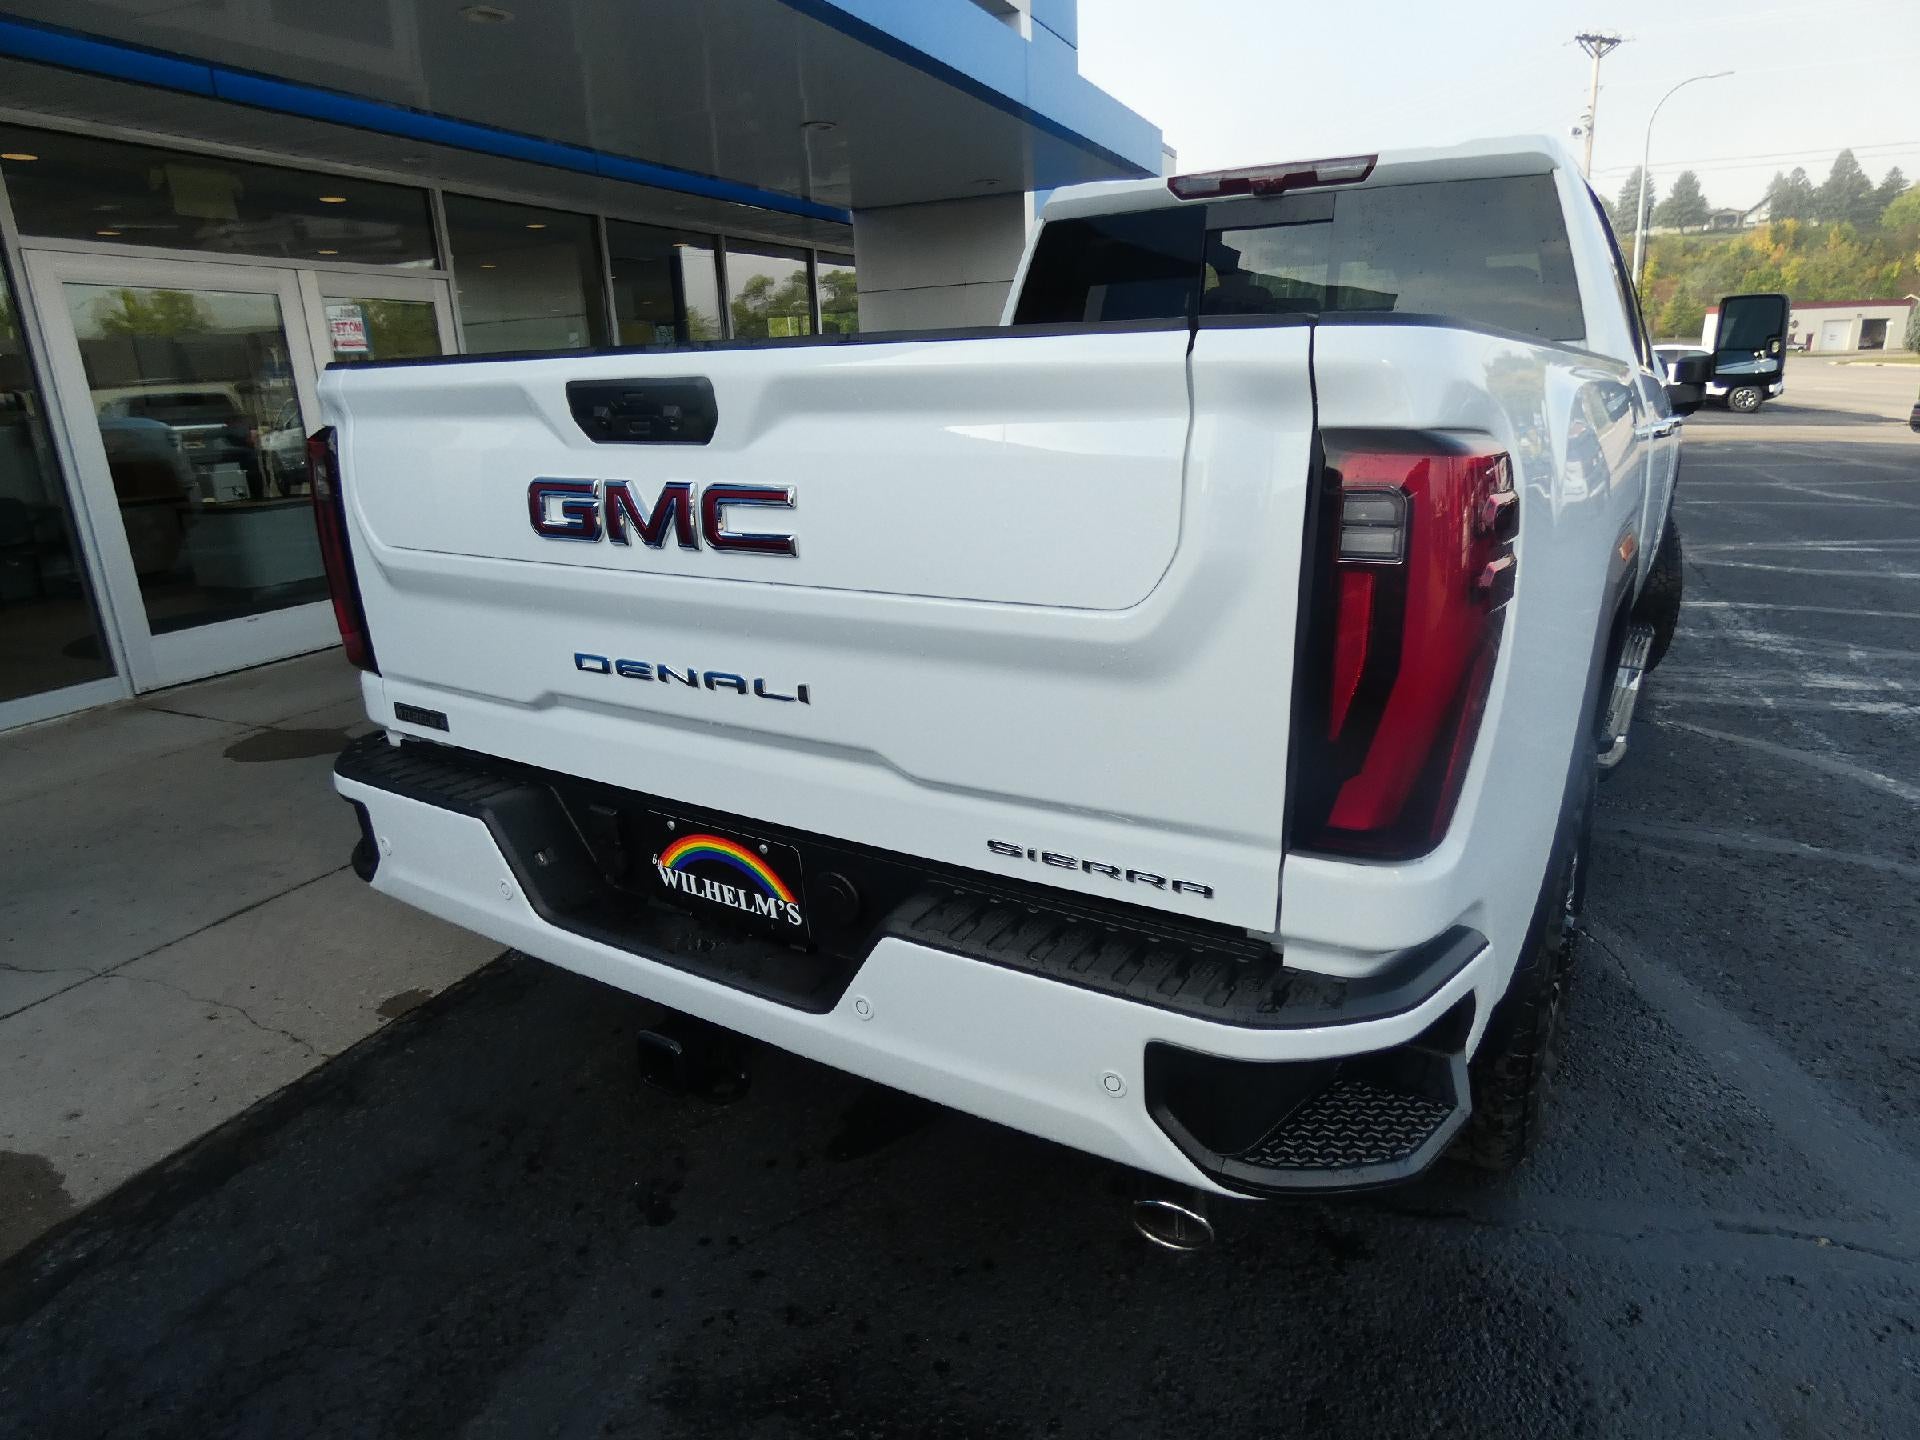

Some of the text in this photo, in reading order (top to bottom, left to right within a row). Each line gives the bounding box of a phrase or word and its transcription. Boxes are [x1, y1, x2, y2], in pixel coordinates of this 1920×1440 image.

[528, 476, 799, 558] GMC
[574, 652, 811, 705] DENALI
[658, 866, 802, 926] WILHELM'S
[987, 839, 1214, 899] SIERRA
